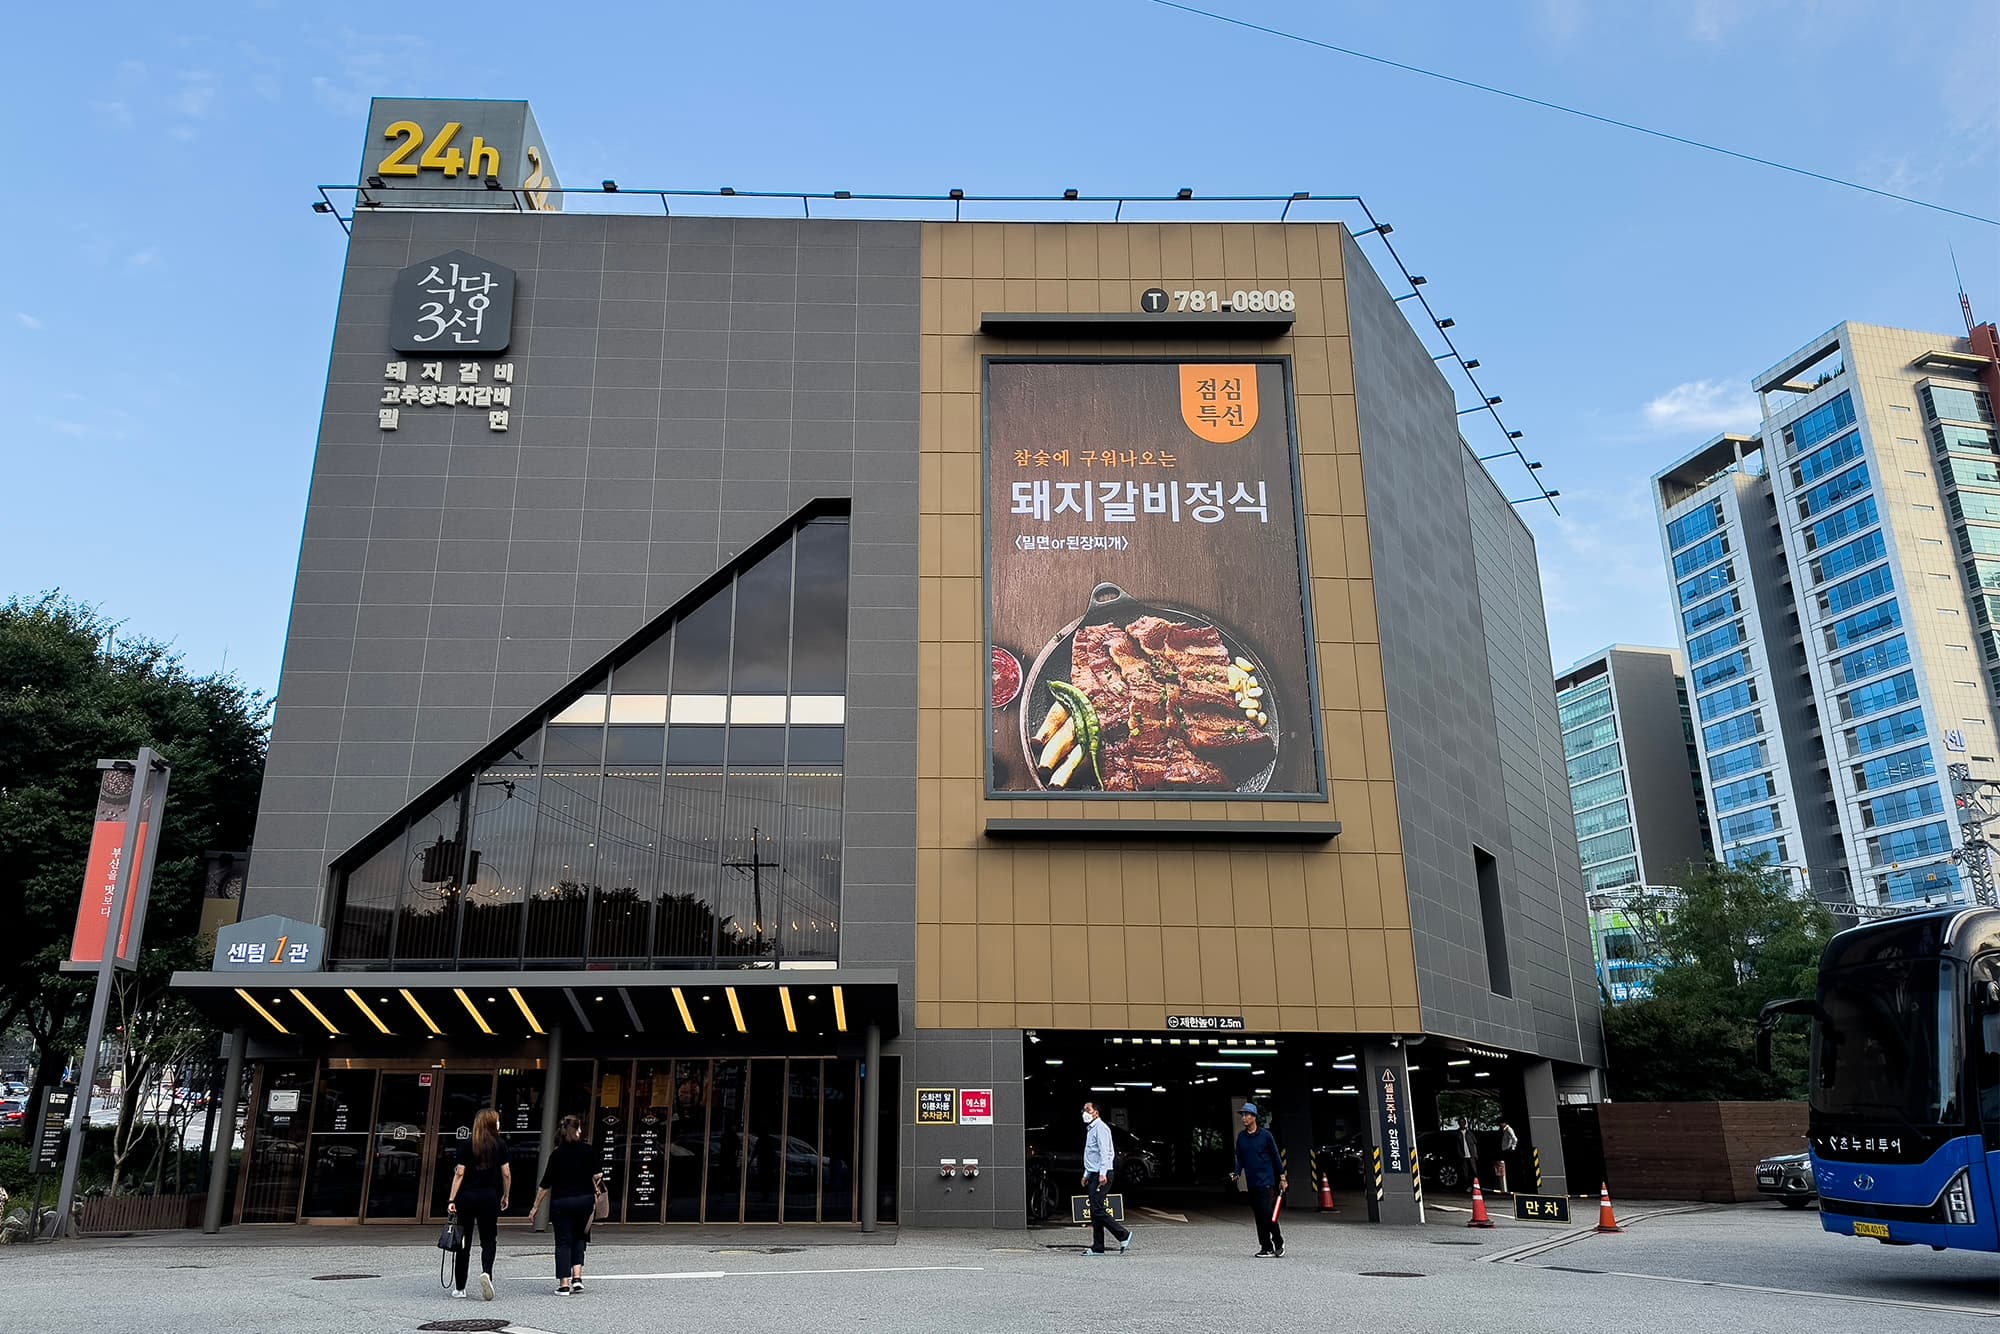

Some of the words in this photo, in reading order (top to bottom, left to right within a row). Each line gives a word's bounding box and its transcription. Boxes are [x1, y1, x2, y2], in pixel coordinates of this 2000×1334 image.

[377, 120, 501, 178] 24h
[416, 263, 499, 312] 식당
[1174, 289, 1297, 312] 781-0808
[413, 301, 483, 345] 3선
[380, 385, 512, 407] 고추장돼지갈비
[1195, 377, 1243, 402] 점심
[1196, 403, 1246, 428] 특선
[1013, 448, 1071, 468] 참숯에
[1079, 448, 1178, 468] 구워나오는
[1010, 479, 1270, 524] 돼지갈비정식
[107, 848, 122, 880] 부산을
[100, 885, 116, 917] 맛보다
[227, 943, 267, 963] 센텀
[1179, 1016, 1218, 1029] 제한높이
[1219, 1018, 1242, 1028] 2.5m
[920, 1093, 942, 1102] 소화전
[943, 1093, 952, 1102] 앞
[965, 1098, 987, 1108] 에스원
[1383, 1082, 1397, 1125] 셀프주차
[922, 1111, 950, 1120] 주차금지
[1388, 1128, 1402, 1171] 안전주의
